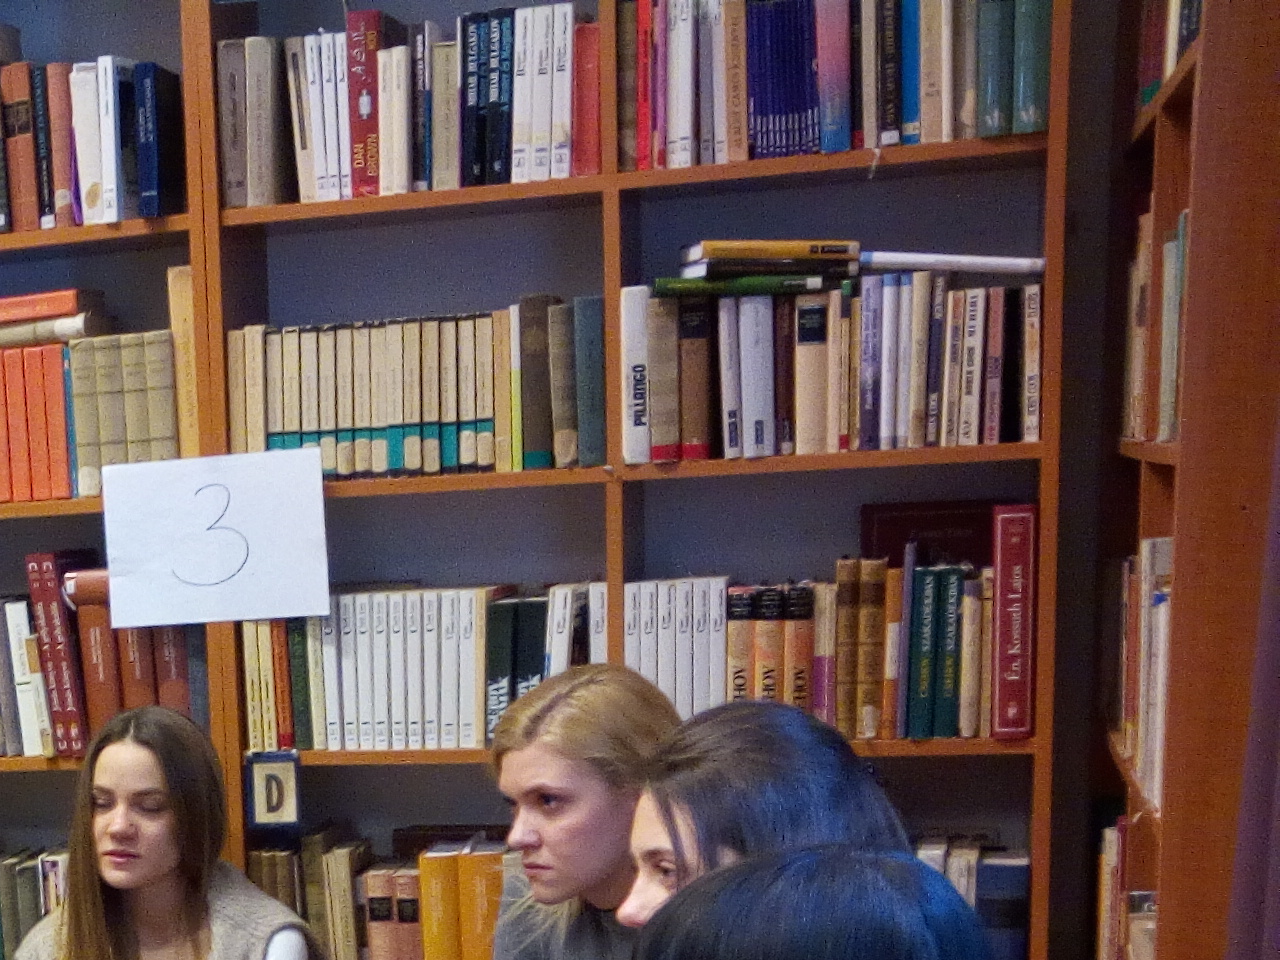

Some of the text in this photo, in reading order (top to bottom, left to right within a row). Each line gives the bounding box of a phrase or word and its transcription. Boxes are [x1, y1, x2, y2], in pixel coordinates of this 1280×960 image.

[353, 143, 364, 168] DAN
[367, 133, 378, 176] BROWN
[172, 483, 249, 586] 3
[265, 773, 284, 814] D
